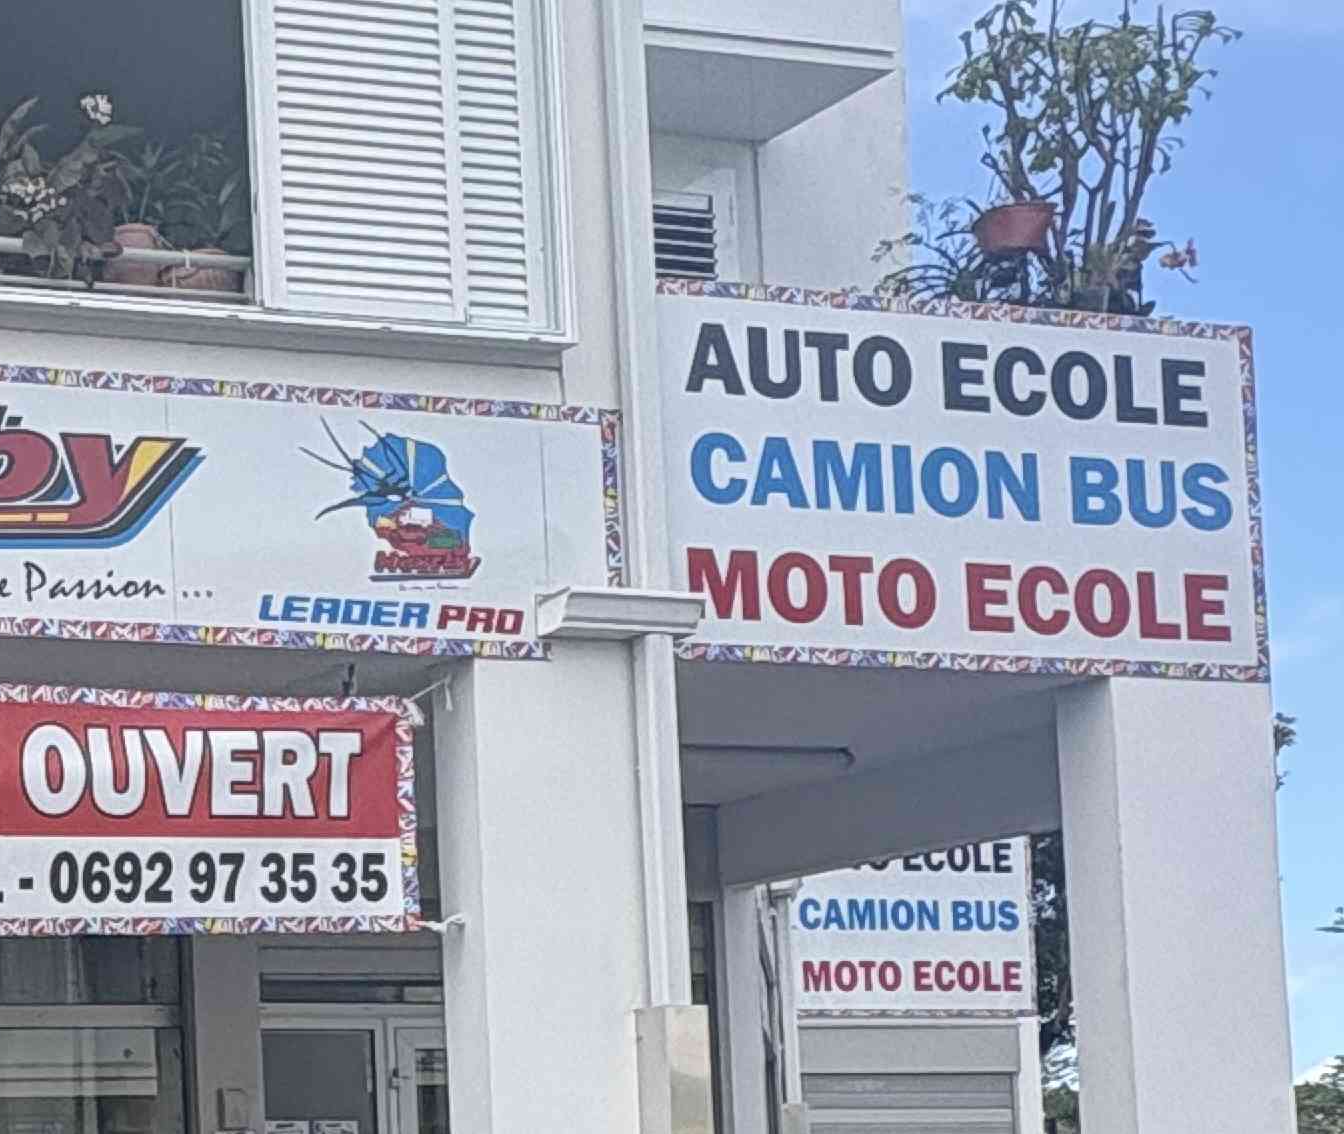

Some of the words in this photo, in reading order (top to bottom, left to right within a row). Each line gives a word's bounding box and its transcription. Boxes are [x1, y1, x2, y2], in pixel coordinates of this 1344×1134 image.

[684, 322, 912, 407] AUTO
[940, 341, 1210, 428] ECOLE
[690, 432, 1041, 521] CAMION
[1069, 456, 1233, 531] BUS
[22, 560, 168, 602] Passion
[686, 548, 936, 630] MOTO
[965, 563, 1232, 642] ECOLE
[258, 594, 431, 629] LEADER
[435, 603, 525, 635] PRO
[19, 721, 364, 820] OUVERT
[48, 850, 174, 905] 0692
[188, 851, 246, 905] 97
[259, 851, 319, 904] 35
[330, 851, 389, 904] 35
[798, 898, 941, 931] CAMION
[951, 899, 1020, 932] BUS
[801, 961, 903, 993] MOTO
[913, 961, 1023, 993] ECOLE
